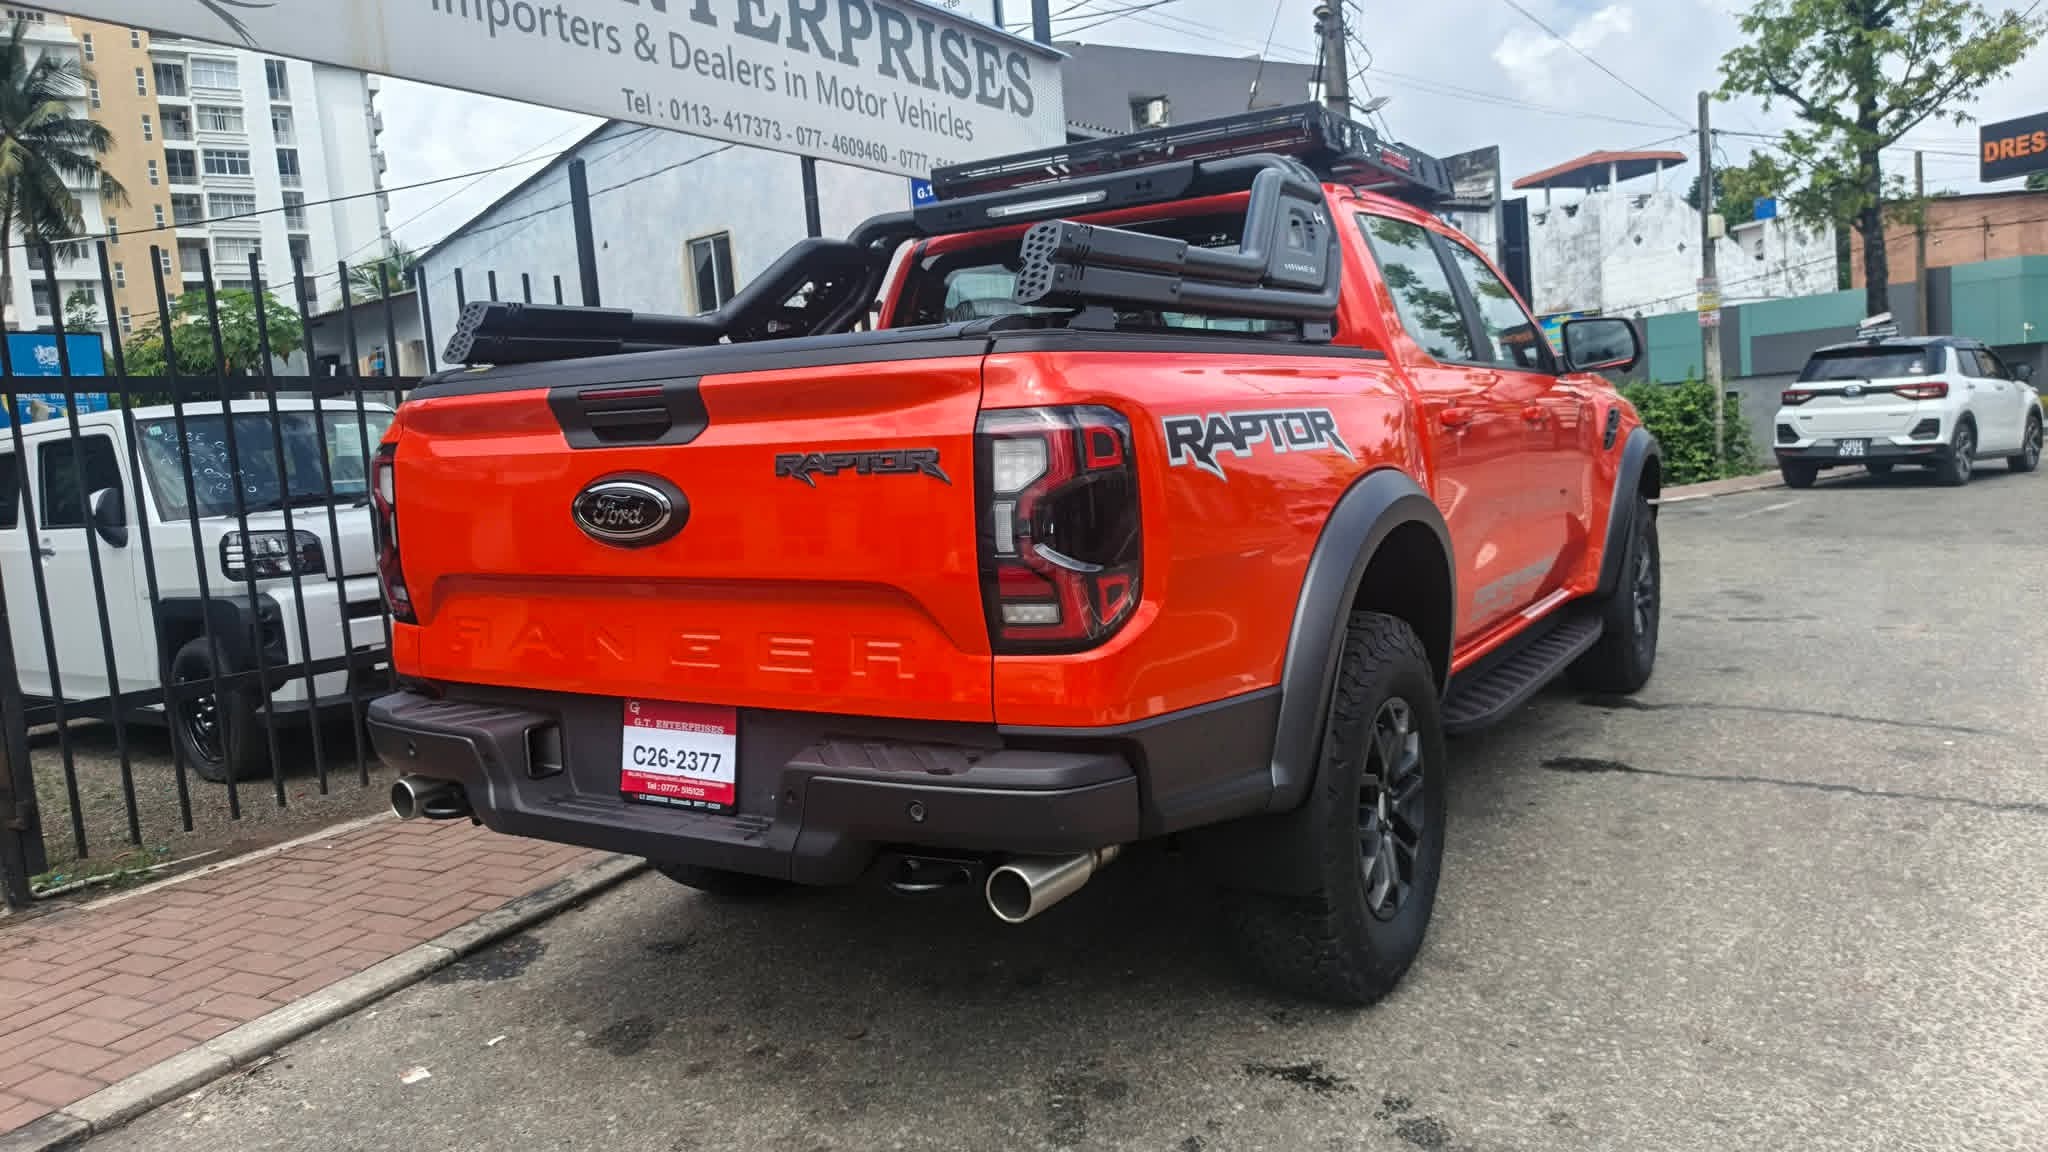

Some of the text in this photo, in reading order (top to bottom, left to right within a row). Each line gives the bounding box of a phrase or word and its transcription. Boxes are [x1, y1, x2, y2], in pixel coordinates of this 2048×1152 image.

[431, 0, 974, 142] mporters & Dealers in Motor Vehicles
[621, 88, 651, 115] Tel
[723, 110, 782, 141] 417373
[832, 133, 887, 163] 4609460
[775, 448, 952, 488] RAPTOR
[1160, 407, 1358, 484] RAPTOR
[592, 494, 644, 525] Ford
[452, 614, 916, 680] RANGER
[656, 719, 725, 735] ENTERPRISES
[633, 745, 722, 774] C26-2377
